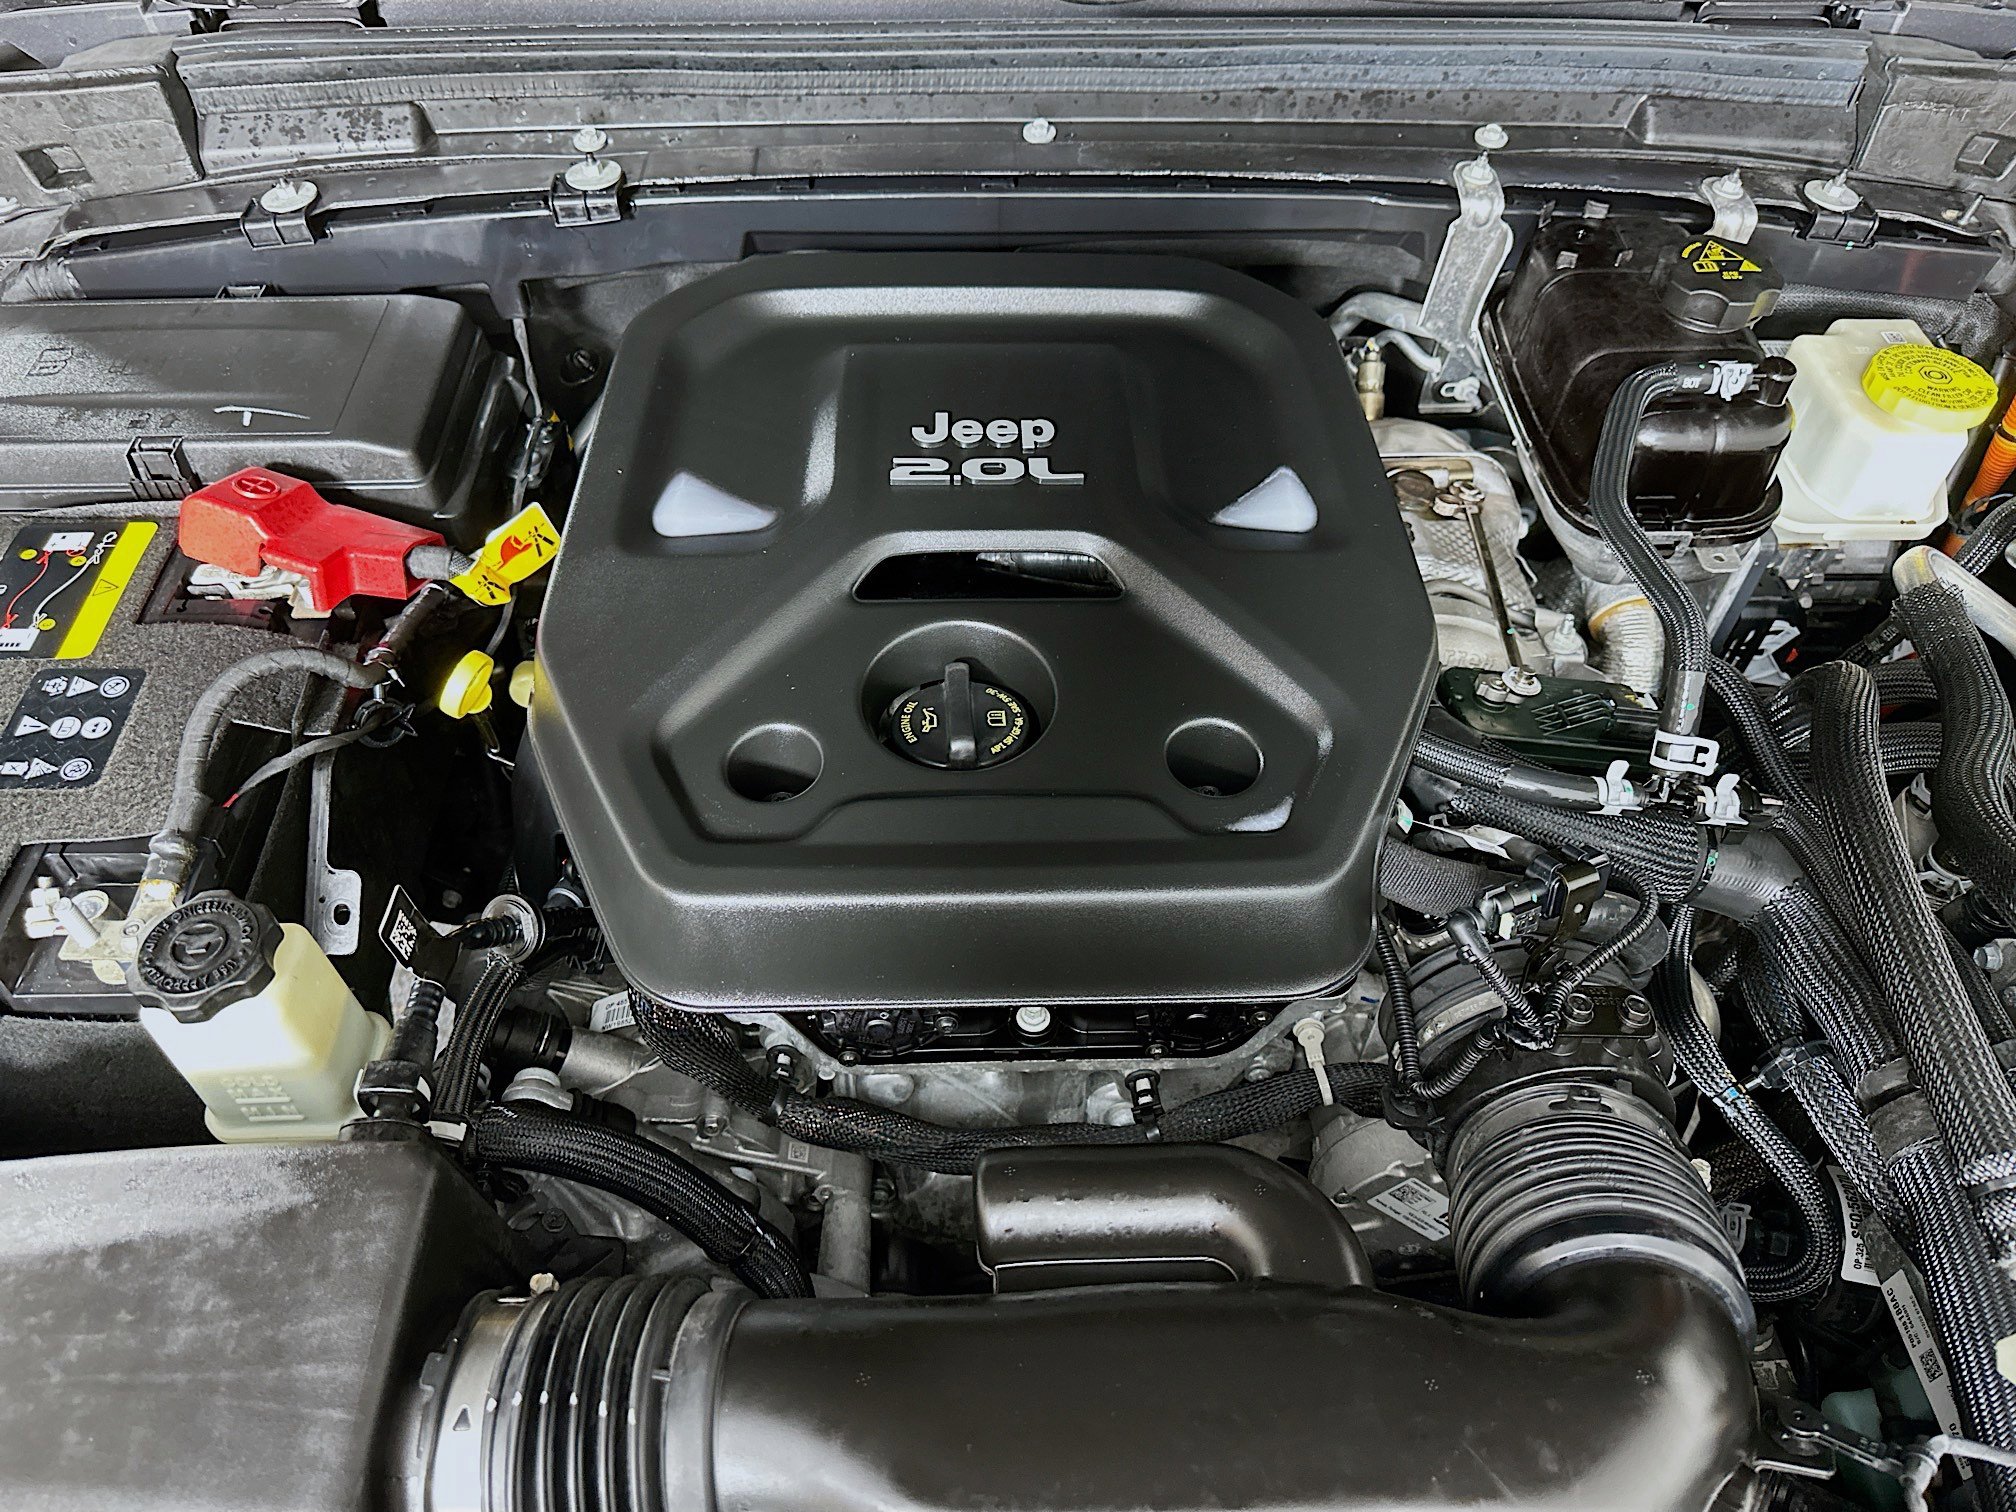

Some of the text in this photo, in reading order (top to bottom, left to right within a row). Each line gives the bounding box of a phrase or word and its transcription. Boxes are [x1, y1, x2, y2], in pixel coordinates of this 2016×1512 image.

[911, 411, 1056, 453] Jeep
[889, 457, 1085, 486] 2.0L
[985, 687, 1012, 703] 5W-30
[1007, 701, 1021, 713] SAE
[901, 701, 919, 744] ENGINE OIL
[990, 742, 1007, 755] API
[171, 900, 235, 924] STEERING
[146, 959, 238, 991] USE APPROVED
[240, 1104, 300, 1118] MIN
